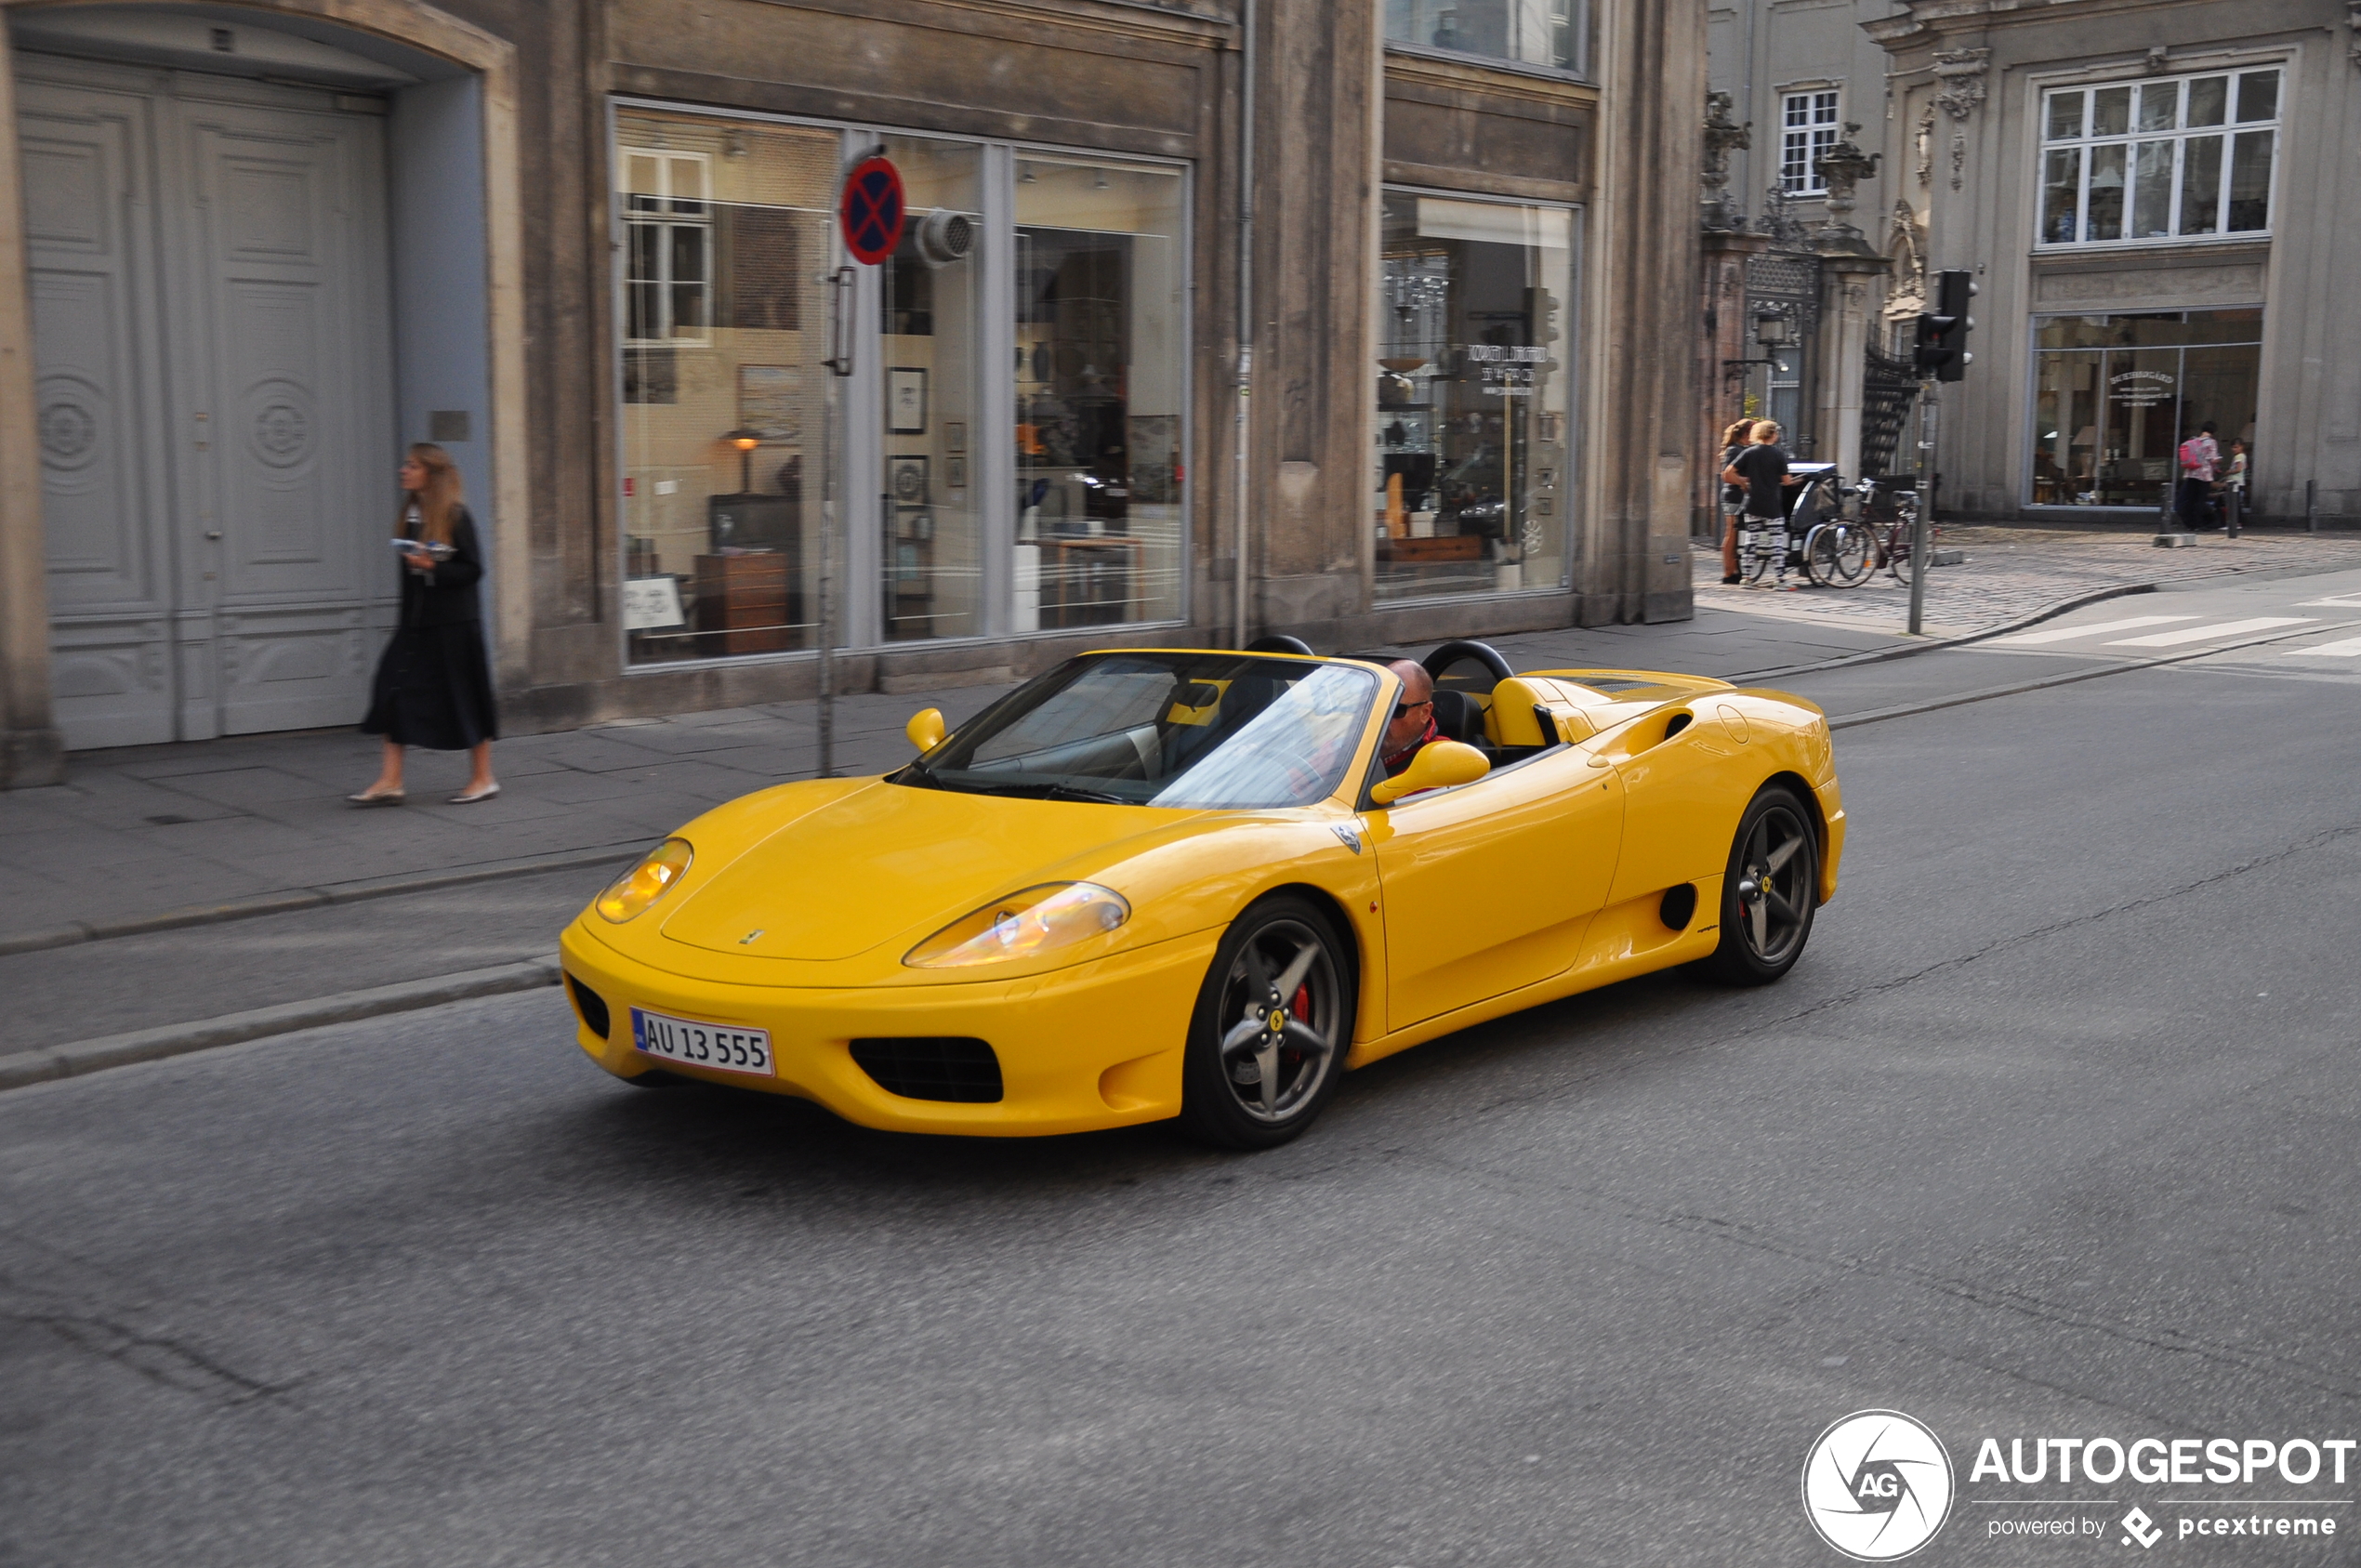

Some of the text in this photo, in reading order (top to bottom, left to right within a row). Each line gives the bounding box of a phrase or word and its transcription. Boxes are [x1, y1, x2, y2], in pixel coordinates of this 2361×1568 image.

[648, 1020, 766, 1067] AU 13 555
